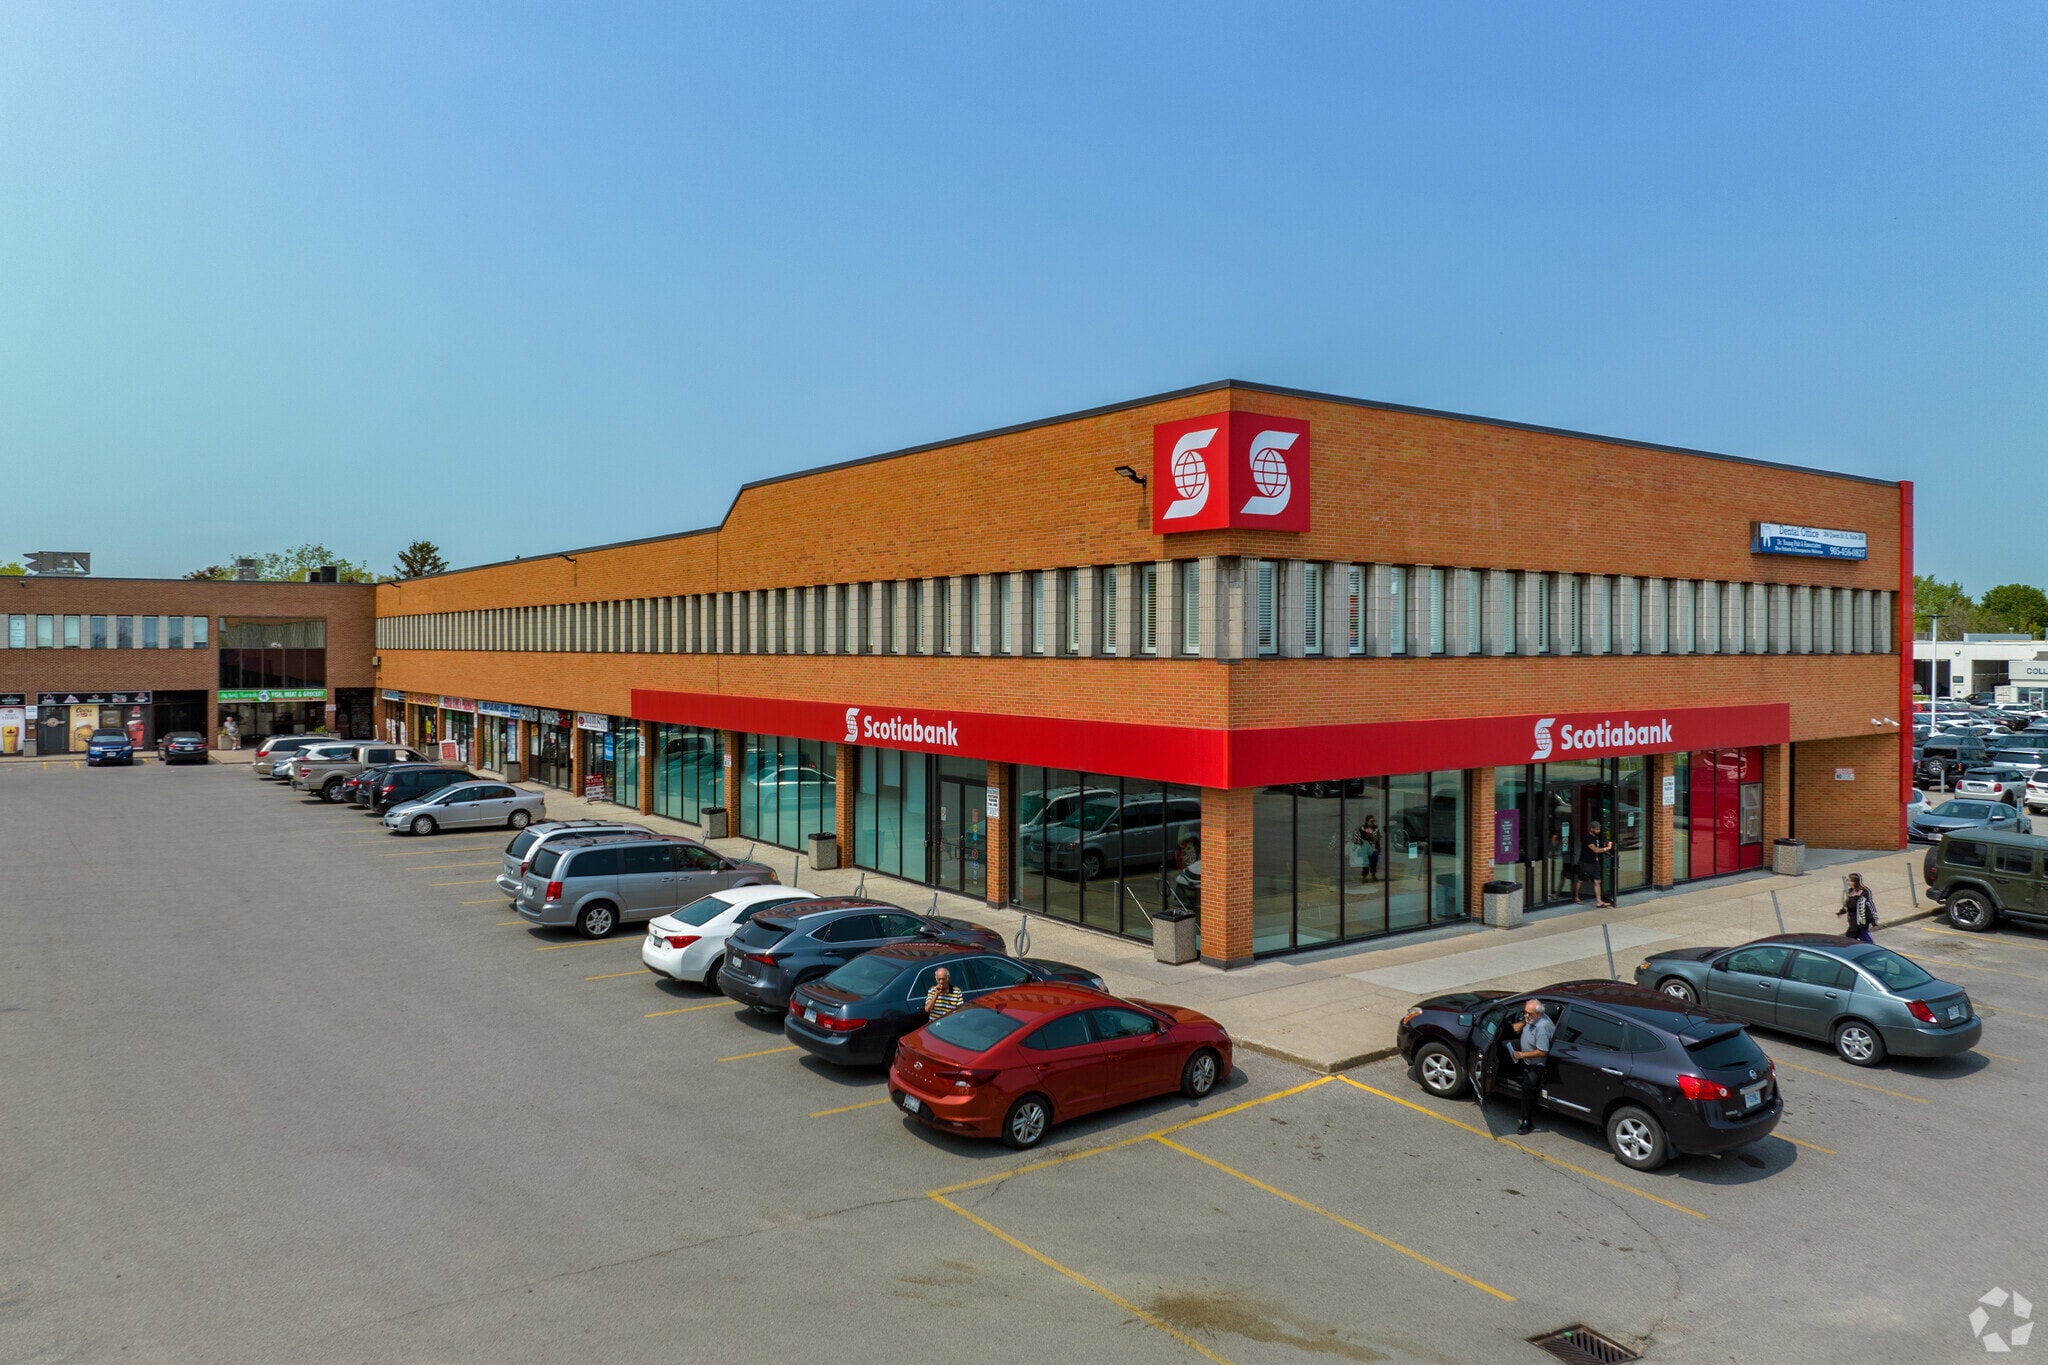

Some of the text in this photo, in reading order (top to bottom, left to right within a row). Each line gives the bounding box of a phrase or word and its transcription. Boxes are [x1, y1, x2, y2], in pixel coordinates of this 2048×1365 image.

[1779, 525, 1819, 538] Dental Office
[863, 715, 958, 747] Scotiabank
[1560, 718, 1673, 751] Scotiabank
